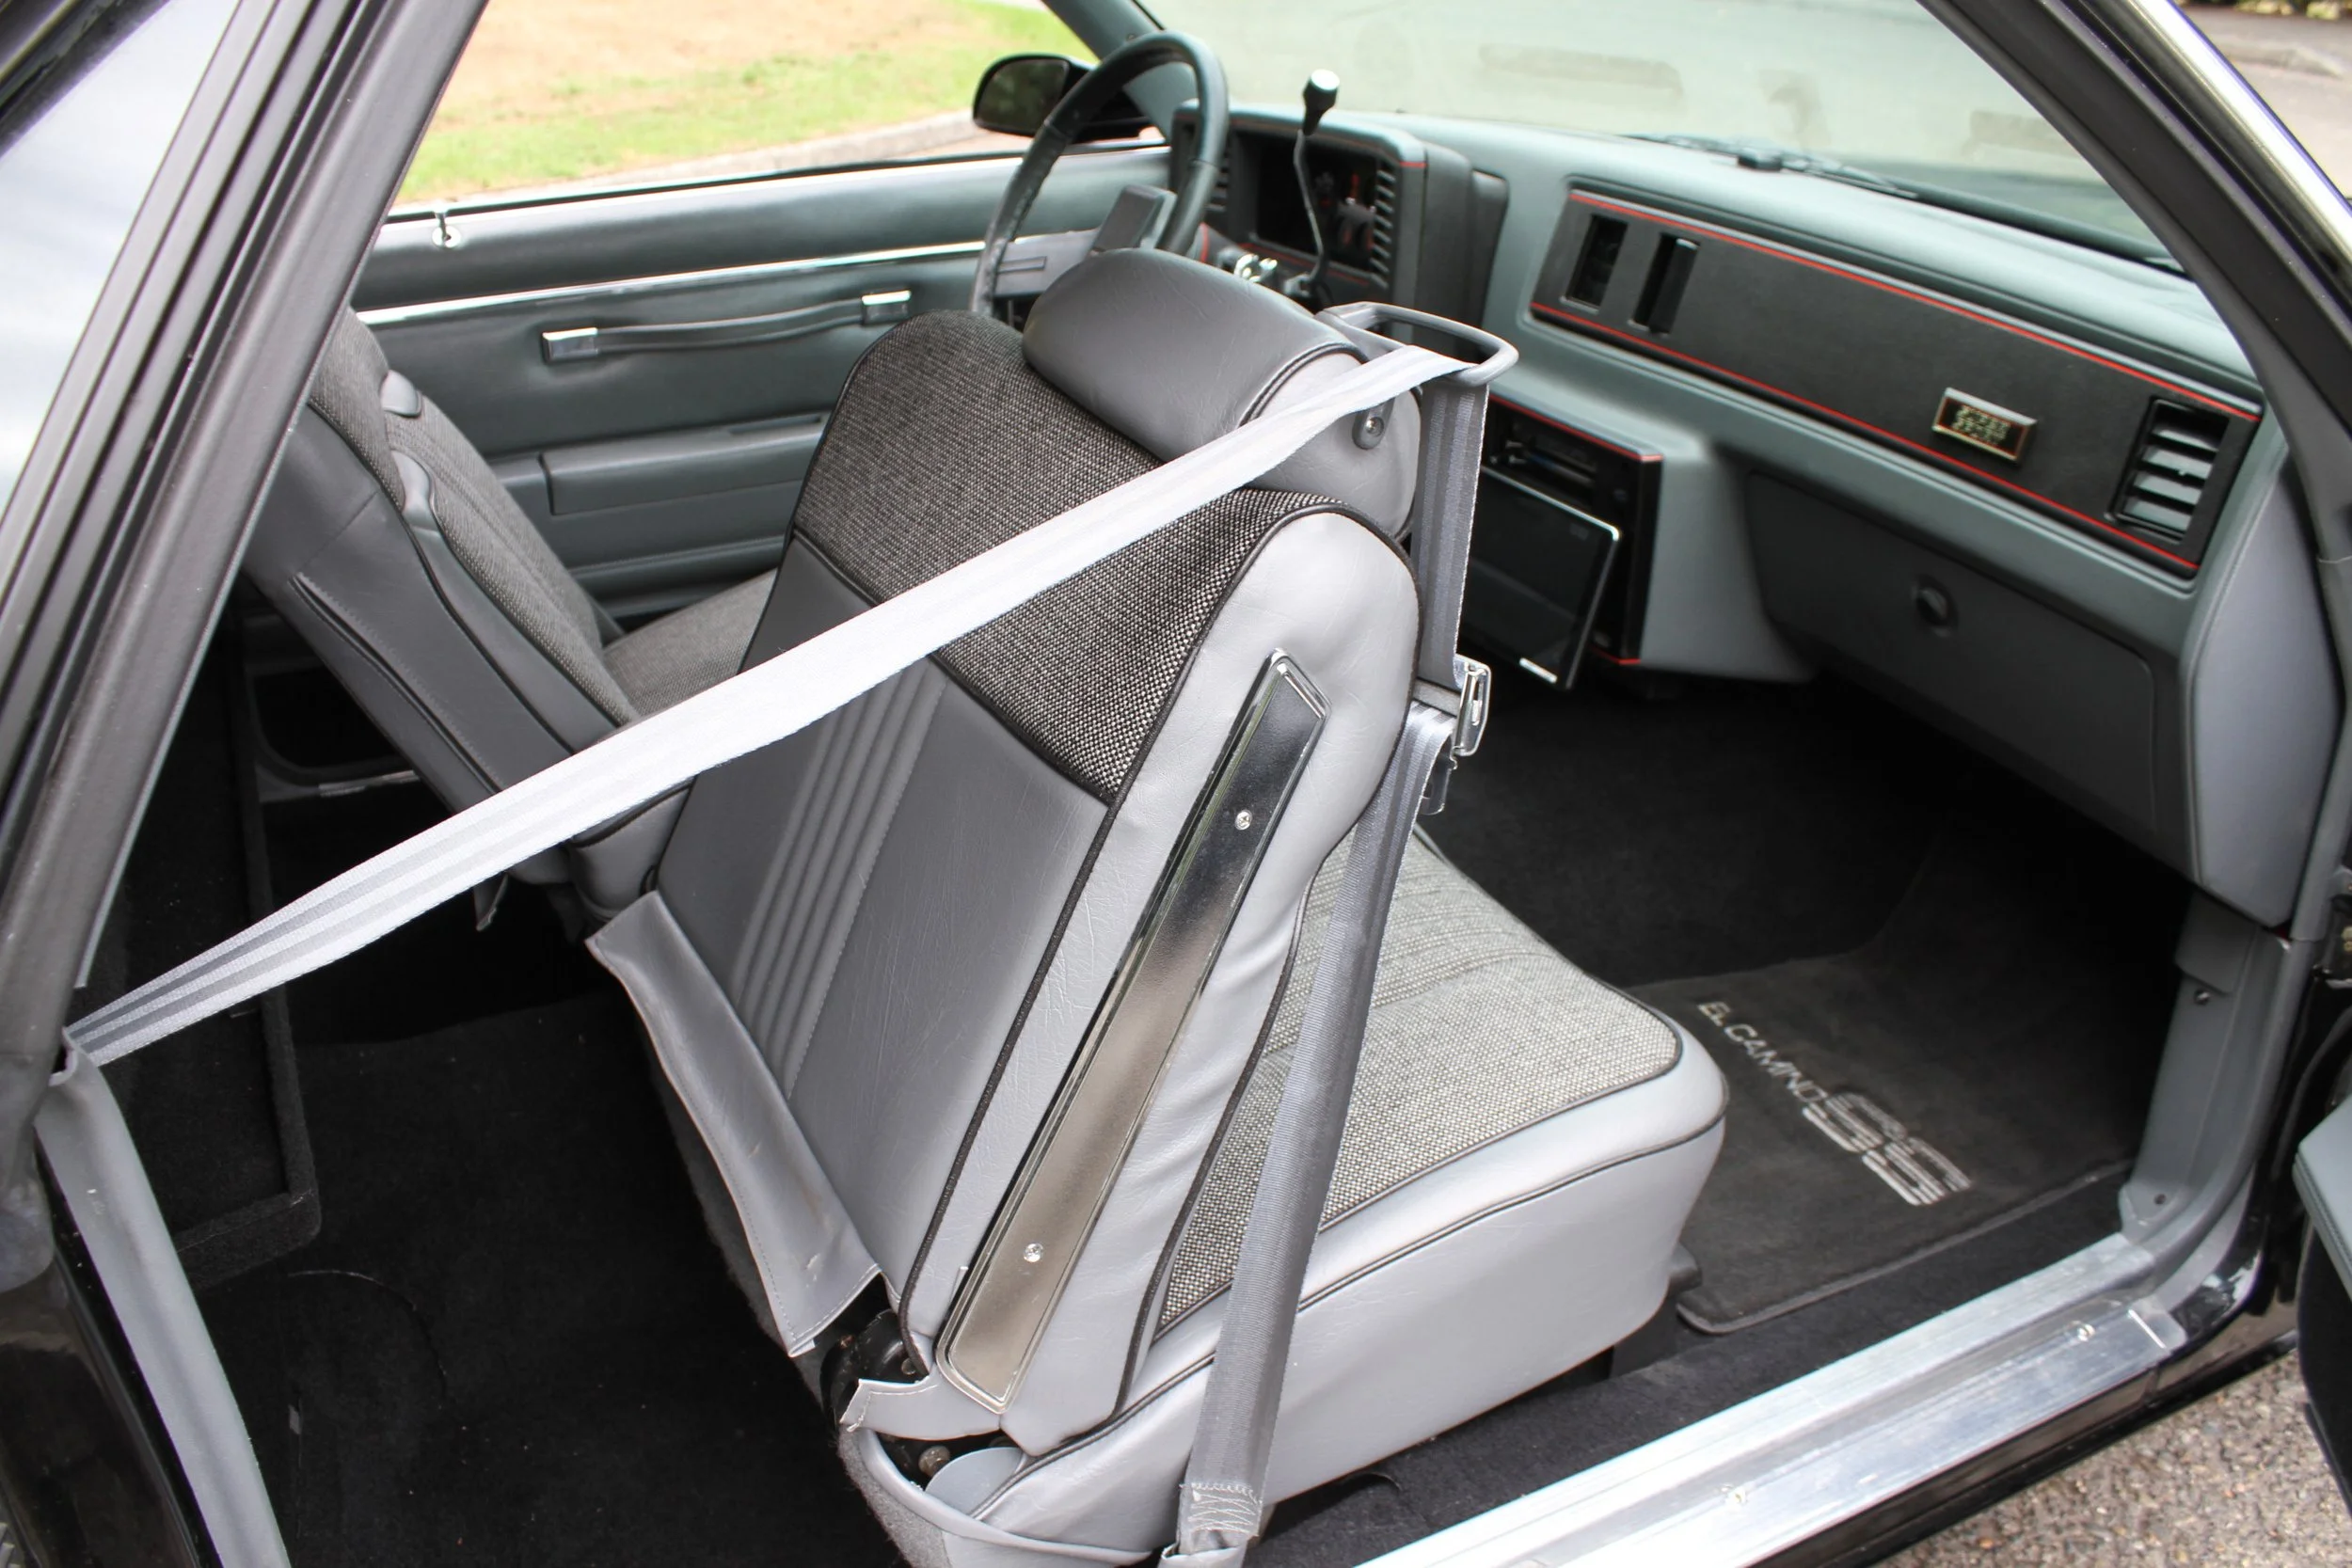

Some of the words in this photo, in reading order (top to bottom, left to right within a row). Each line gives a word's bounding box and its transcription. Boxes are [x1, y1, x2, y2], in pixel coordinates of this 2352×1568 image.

[1697, 1001, 1731, 1026] EL
[1724, 1023, 1827, 1103] CAMINO
[1803, 1092, 1971, 1205] SS
